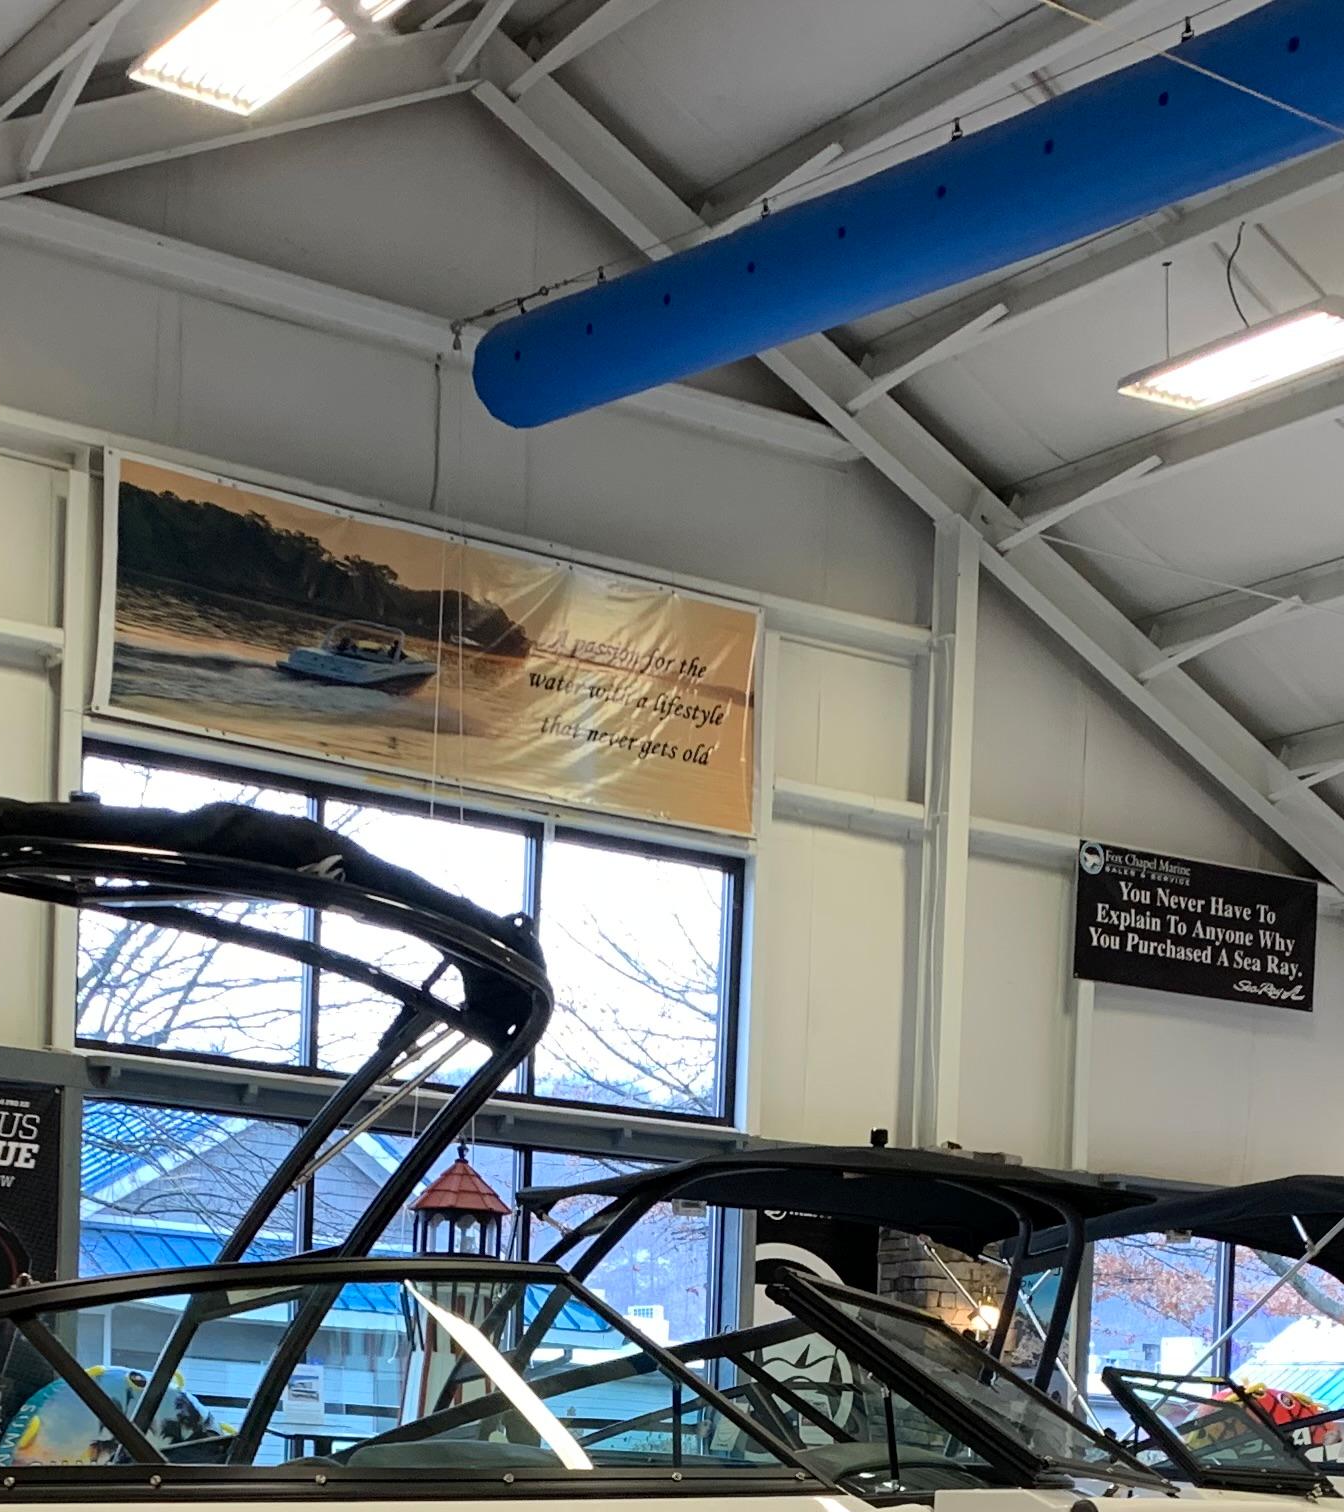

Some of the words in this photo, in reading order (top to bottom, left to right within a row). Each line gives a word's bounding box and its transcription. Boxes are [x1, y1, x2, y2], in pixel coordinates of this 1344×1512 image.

[570, 637, 640, 669] passion
[640, 648, 676, 674] for
[679, 656, 707, 679] the
[529, 672, 583, 694] water
[589, 684, 630, 706] with
[636, 696, 647, 709] a
[653, 693, 725, 728] lifestyle
[541, 716, 579, 736] that
[587, 728, 640, 751] never
[638, 741, 676, 760] gets
[682, 743, 714, 766] old
[1105, 850, 1124, 865] Fox
[1124, 853, 1157, 873] Chapel
[1159, 859, 1191, 876] Marine
[1119, 881, 1151, 905] You
[1156, 886, 1205, 914] Never
[1210, 896, 1251, 921] Have
[1256, 904, 1276, 925] To
[1088, 926, 1120, 950] You
[1126, 932, 1212, 965] Purchased
[1216, 949, 1230, 968] A
[1233, 951, 1261, 973] Sea
[1266, 955, 1304, 981] Ray.
[1096, 903, 1161, 932] Explain
[1166, 914, 1188, 936] To
[1192, 923, 1254, 947] Anyone
[1259, 930, 1296, 957] Why
